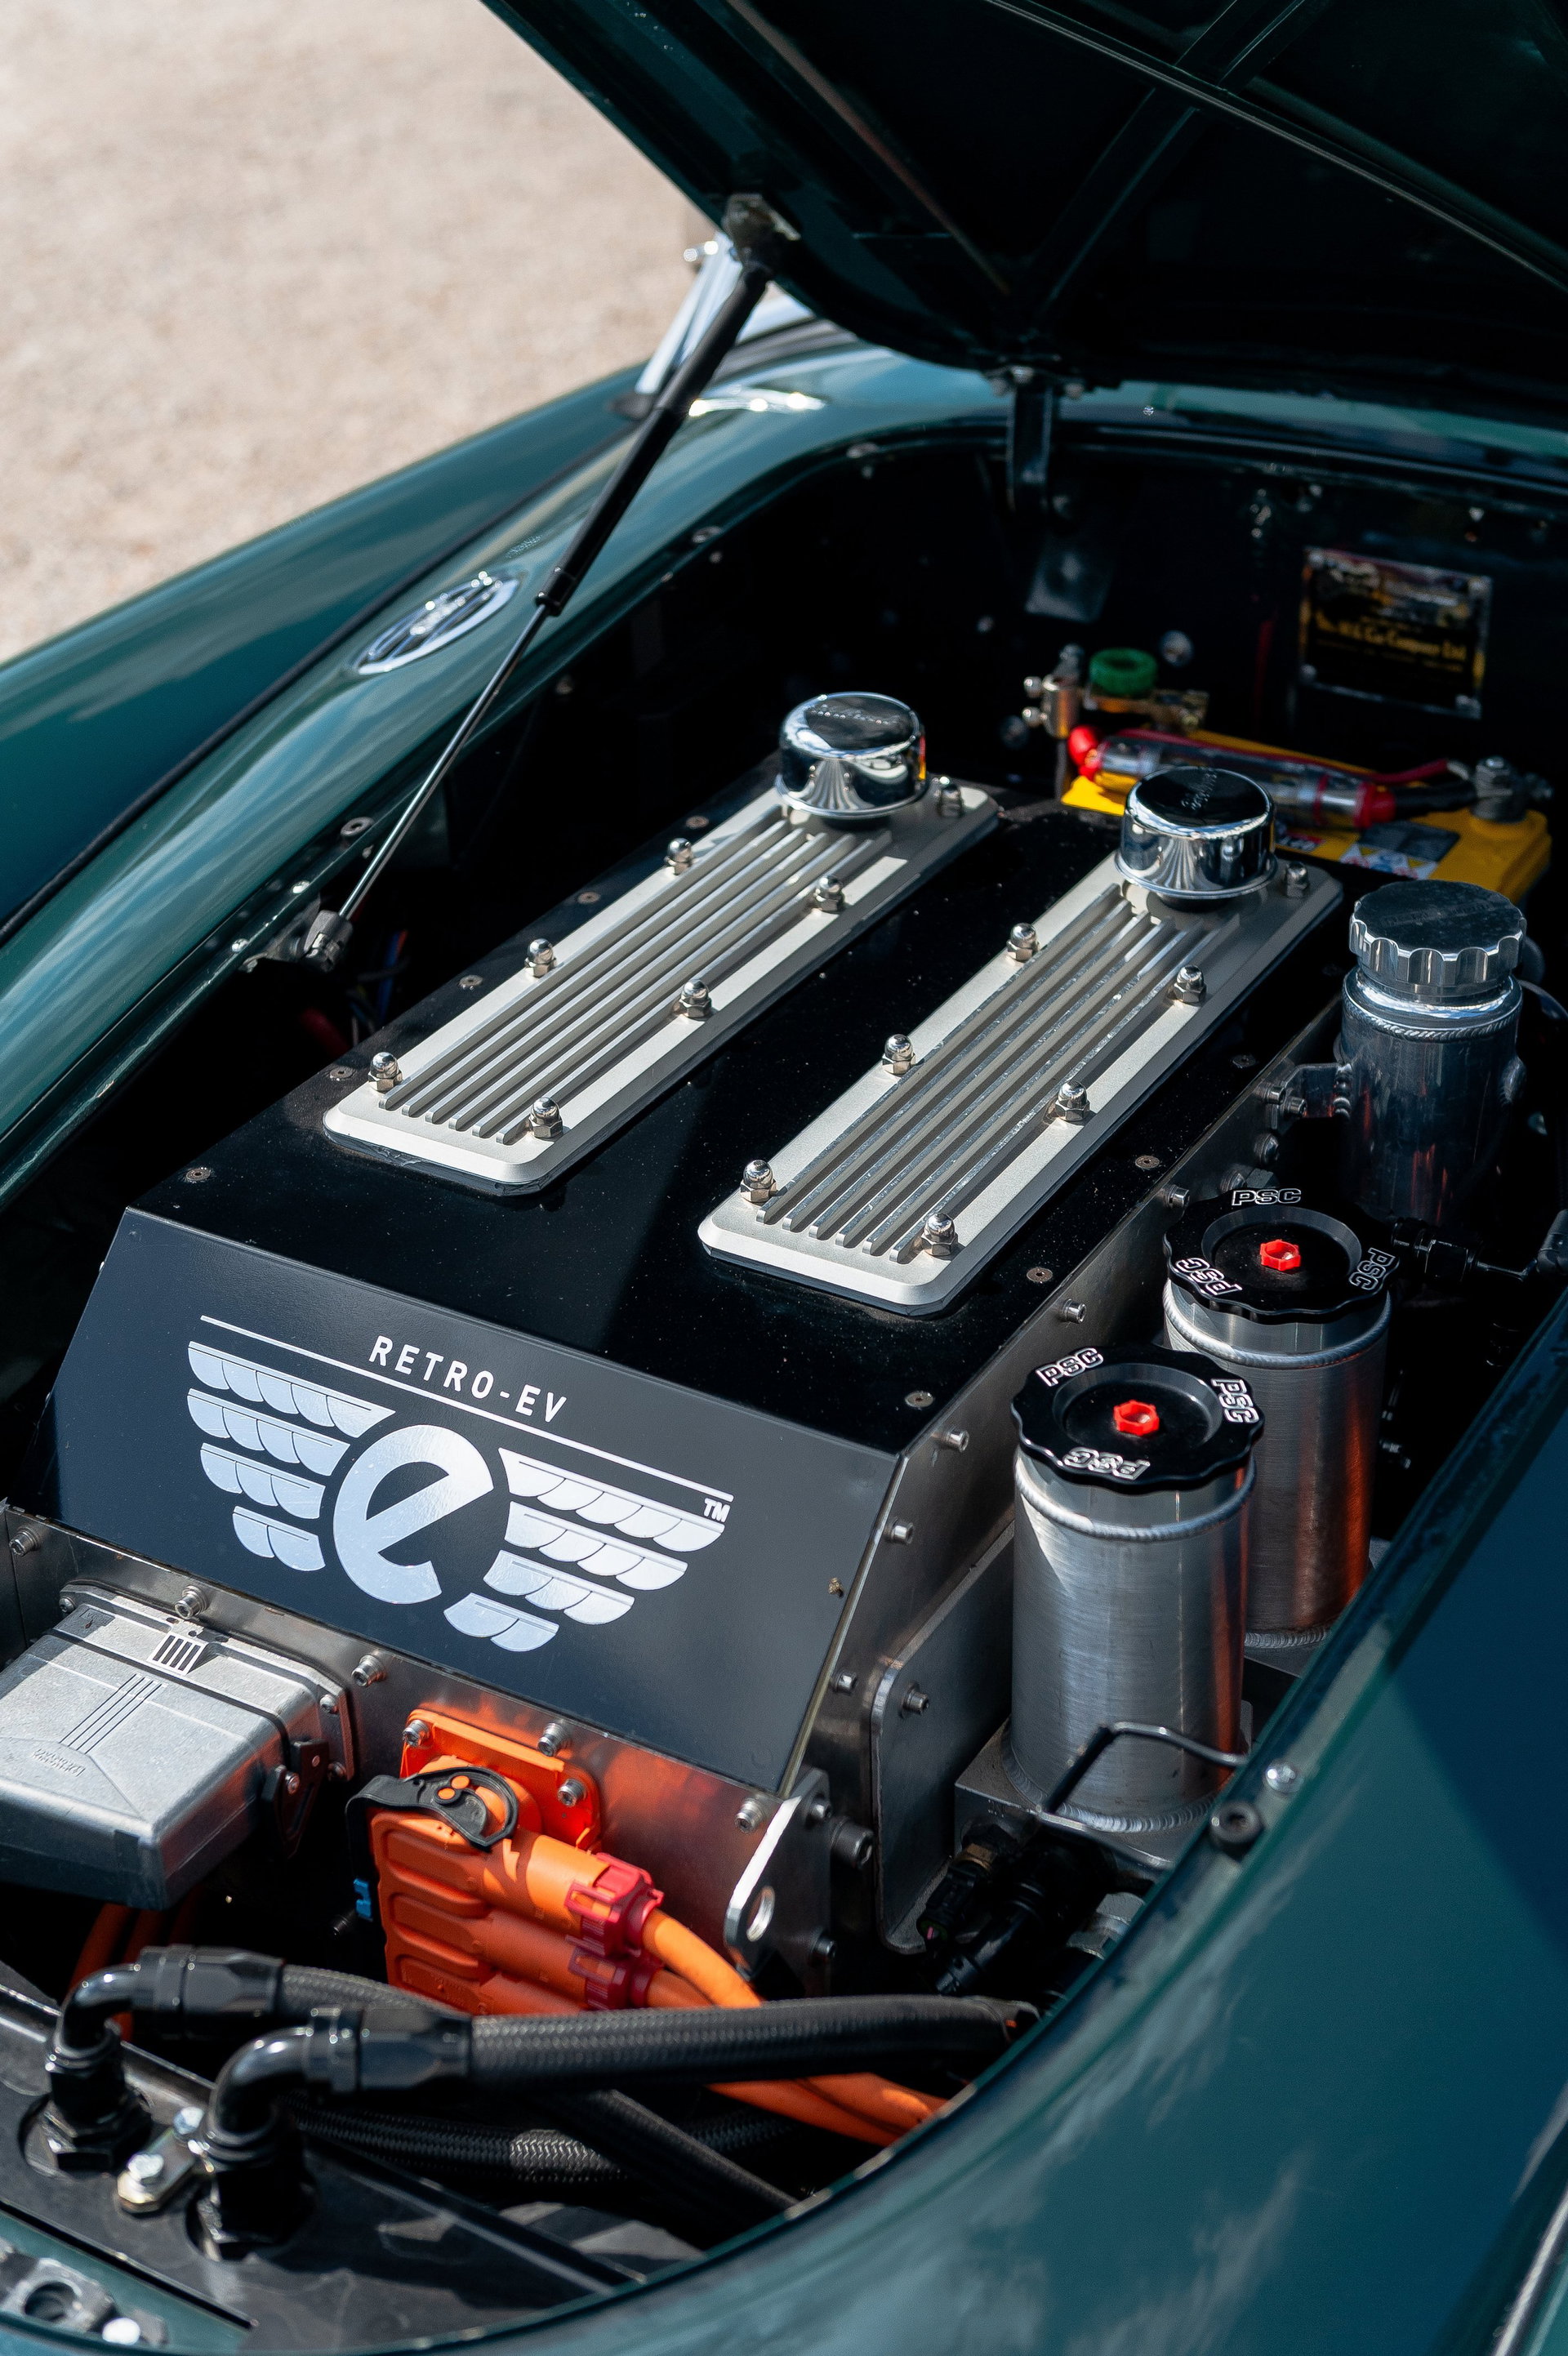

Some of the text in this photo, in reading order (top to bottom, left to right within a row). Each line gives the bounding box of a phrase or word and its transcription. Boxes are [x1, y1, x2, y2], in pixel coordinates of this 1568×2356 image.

[1232, 1187, 1302, 1206] PSC
[1174, 1256, 1243, 1297] PSC
[1348, 1247, 1396, 1292] PSC
[368, 1334, 568, 1423] RETRO-EV
[1035, 1347, 1105, 1387] PSC
[1210, 1378, 1260, 1424] PSC
[1061, 1446, 1152, 1481] PSC
[703, 1497, 729, 1524] TM
